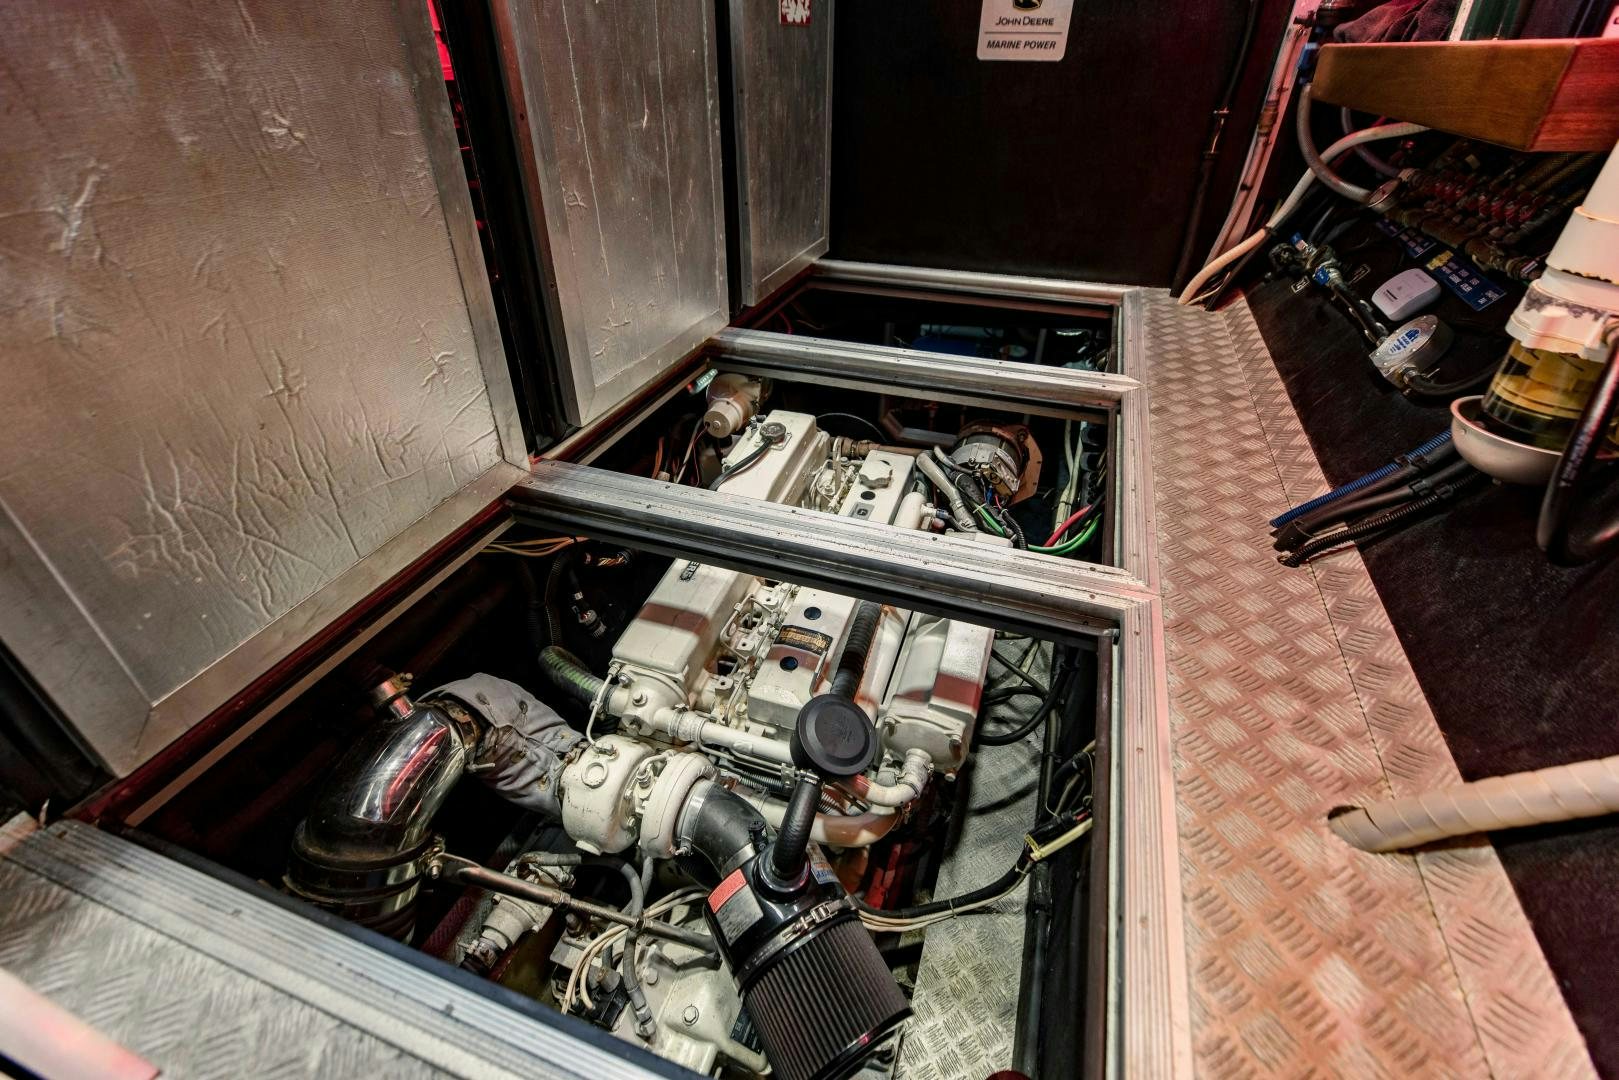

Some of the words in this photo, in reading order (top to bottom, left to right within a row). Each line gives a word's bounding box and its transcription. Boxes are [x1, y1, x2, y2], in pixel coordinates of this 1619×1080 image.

[995, 16, 1020, 26] JOHN
[1023, 16, 1054, 26] DEERE
[986, 40, 1021, 49] MARINE
[1023, 40, 1056, 49] POWER
